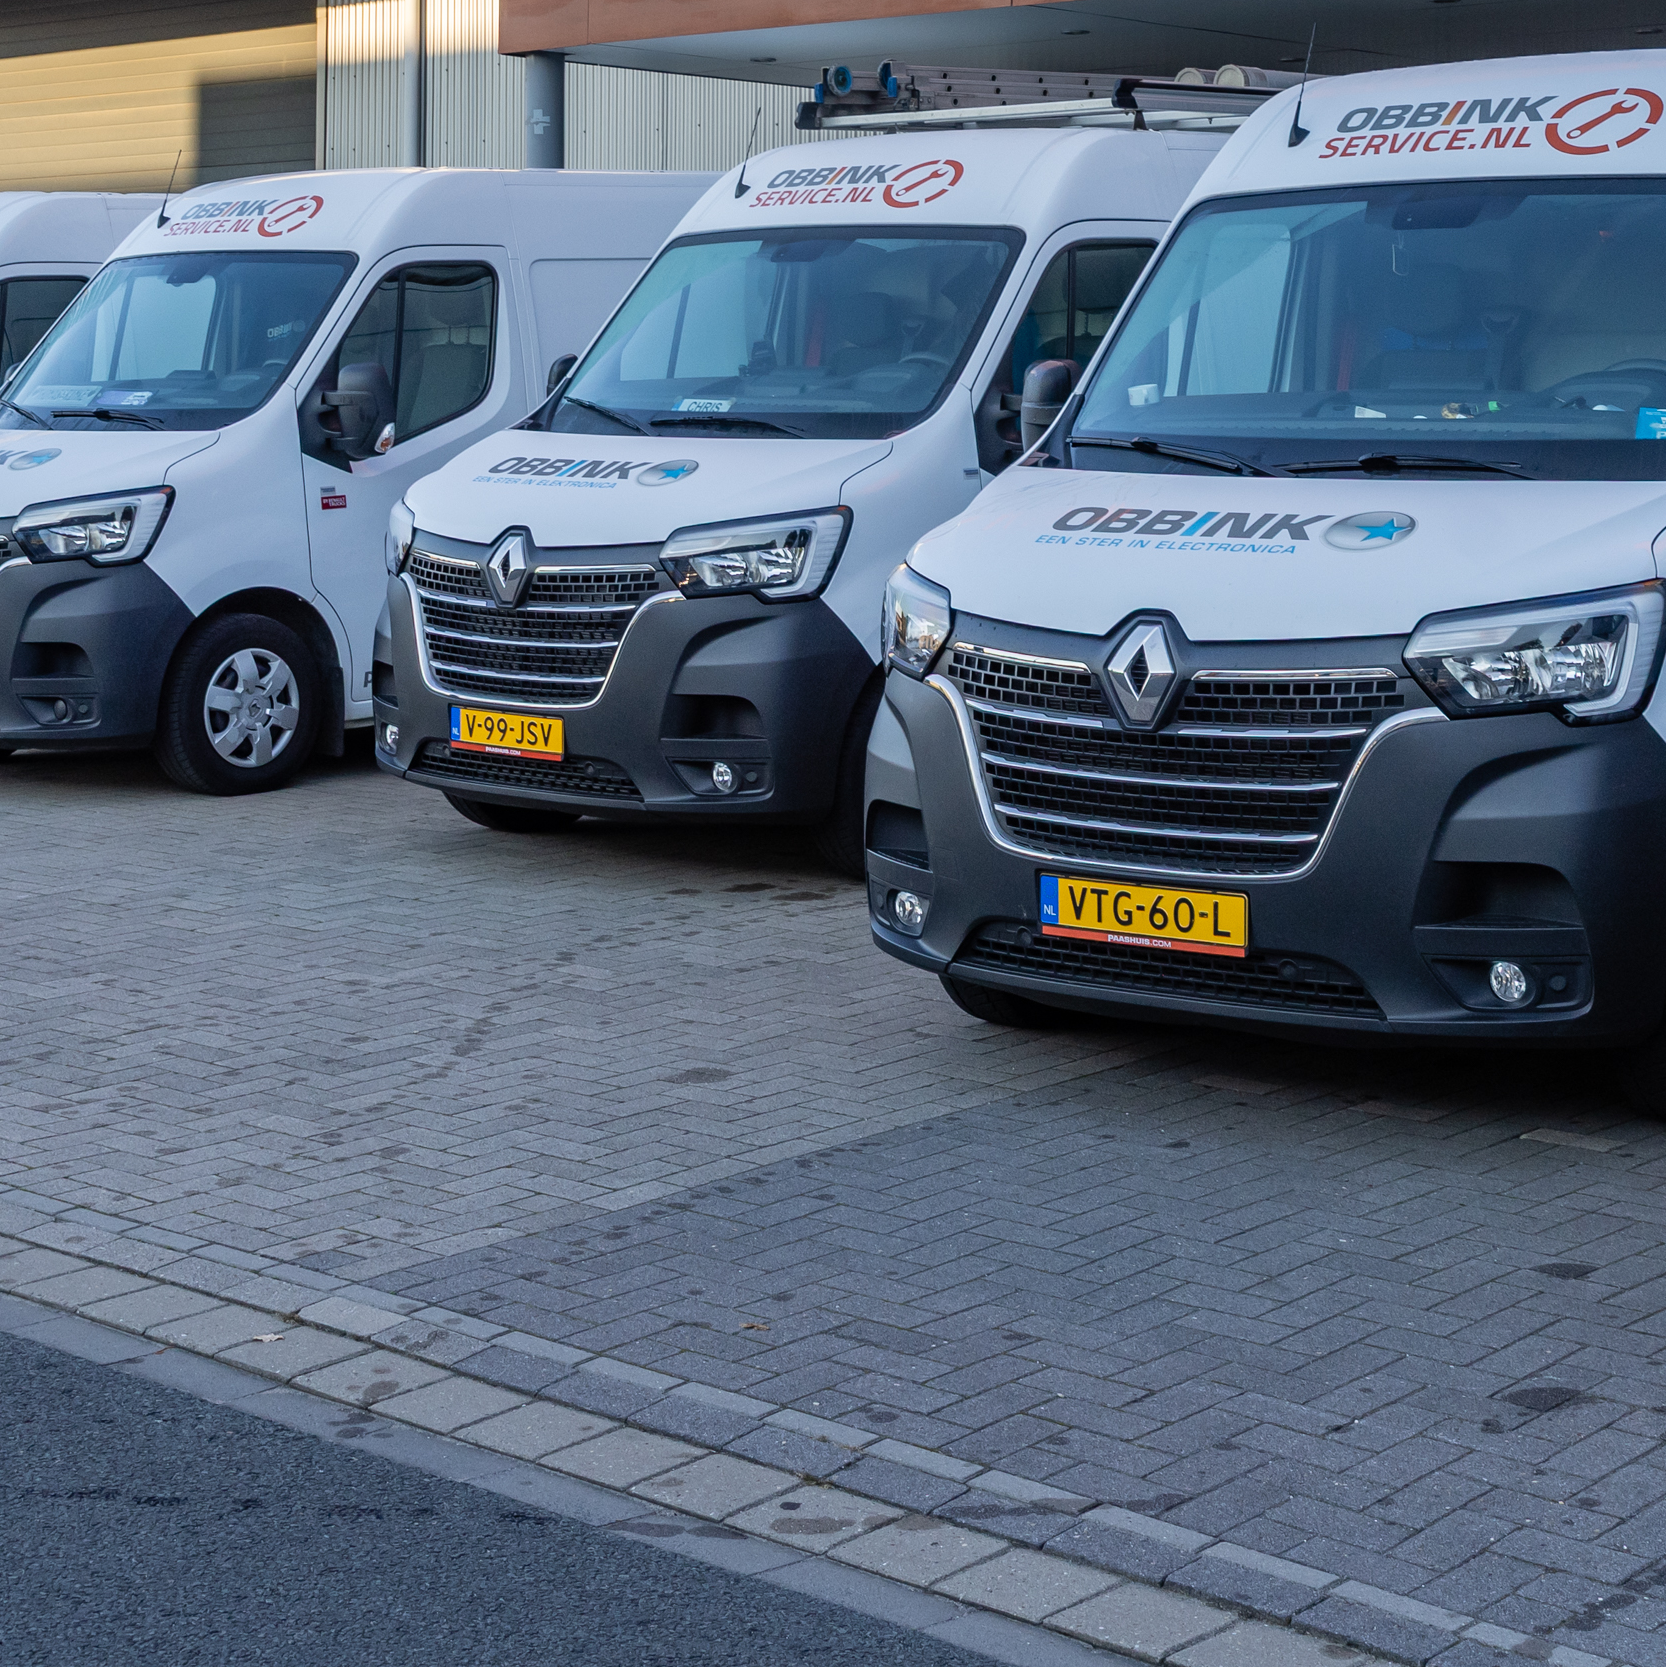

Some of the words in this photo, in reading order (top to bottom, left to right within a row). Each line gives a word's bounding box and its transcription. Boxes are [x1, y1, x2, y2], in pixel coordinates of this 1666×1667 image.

[1336, 95, 1560, 133] OBBINK
[1318, 126, 1532, 159] SERVICE.NL
[767, 163, 903, 189] OBBINK
[749, 186, 877, 208] SERVICE.NL
[180, 199, 280, 220] OBBINK
[163, 218, 255, 237] SERVICE.NL
[687, 401, 722, 412] CHRIS
[488, 456, 655, 480] OBBINK
[472, 475, 493, 483] EEN
[493, 477, 520, 485] STER
[1052, 506, 1336, 541] OBBINK
[1035, 534, 1074, 544] EEN
[1075, 536, 1124, 548] STER
[1127, 539, 1152, 548] IN
[1155, 540, 1296, 554] ELECTRONICA
[465, 713, 552, 747] V-99-JSV
[1043, 904, 1057, 916] NL
[1068, 885, 1231, 938] VTG-60-L
[1107, 933, 1172, 949] PAASHUIS.COM
